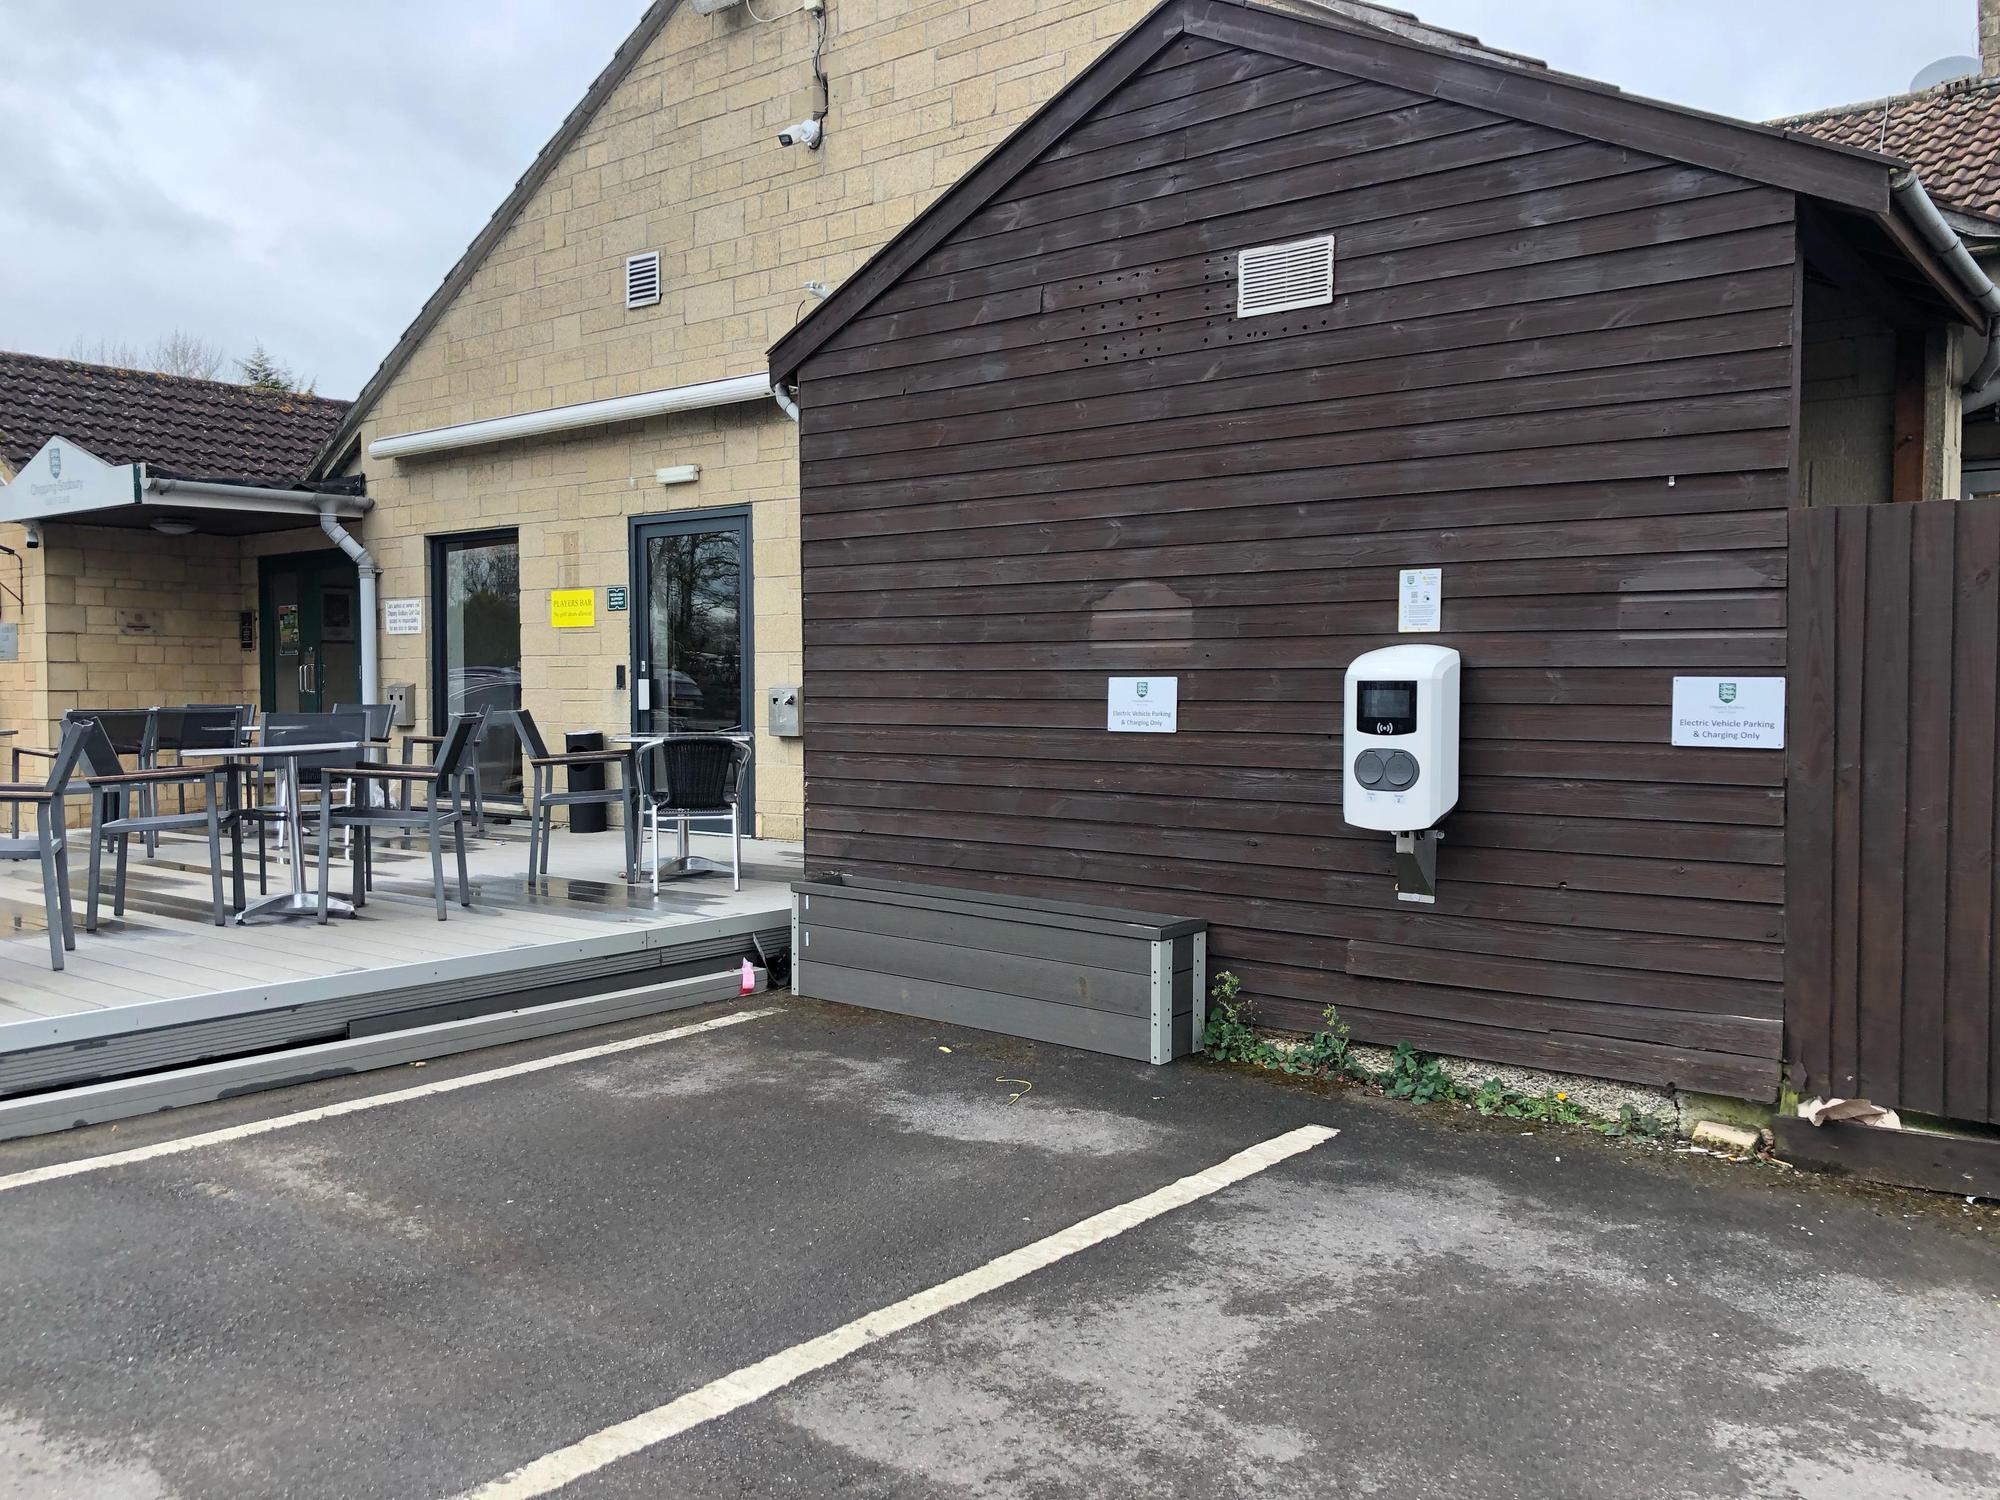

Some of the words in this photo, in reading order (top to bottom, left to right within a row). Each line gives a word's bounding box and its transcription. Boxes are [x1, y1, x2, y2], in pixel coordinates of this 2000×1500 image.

[553, 599, 579, 608] PLAYERS
[579, 599, 592, 607] BAR
[1151, 710, 1171, 718] Parking
[1126, 719, 1150, 727] Charging
[1150, 719, 1163, 727] Only
[1679, 719, 1709, 727] Electric
[1711, 719, 1741, 728] Vehicle
[1743, 720, 1775, 729] Parking
[1702, 730, 1738, 740] Charging
[1740, 731, 1760, 740] Only
